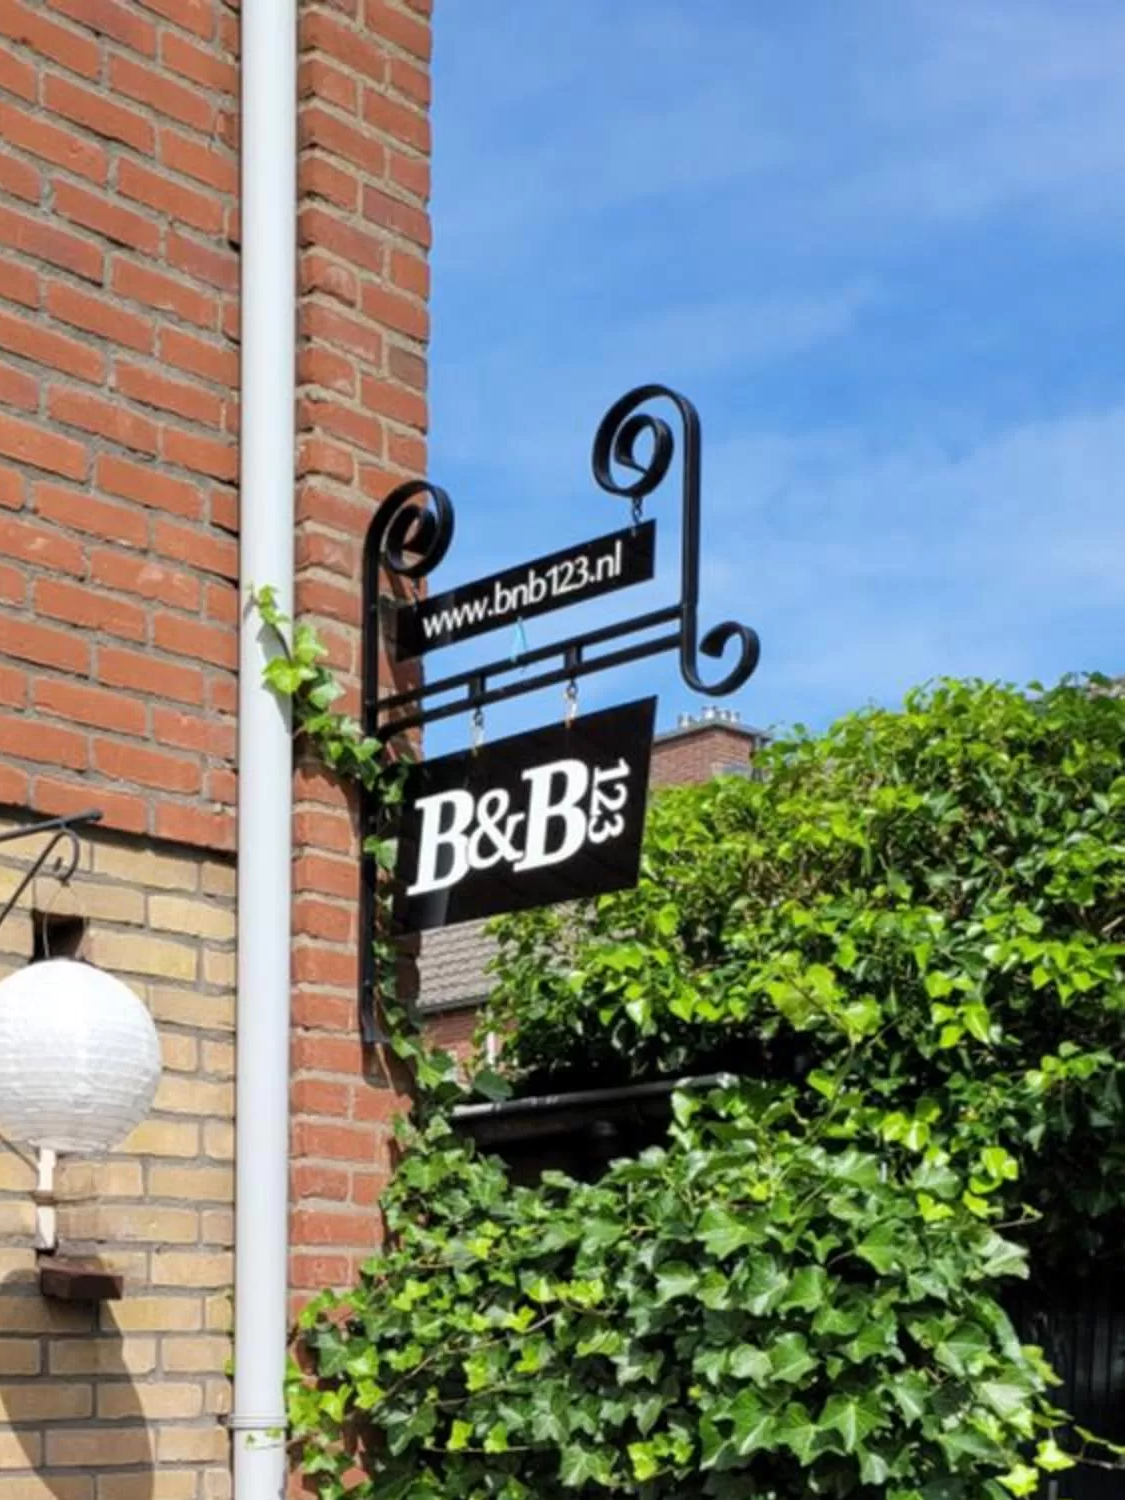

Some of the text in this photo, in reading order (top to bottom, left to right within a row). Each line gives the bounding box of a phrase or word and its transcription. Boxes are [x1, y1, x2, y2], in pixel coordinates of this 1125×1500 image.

[421, 539, 622, 639] www.bnb123.nl
[406, 758, 589, 896] B&B
[589, 757, 630, 844] 123
